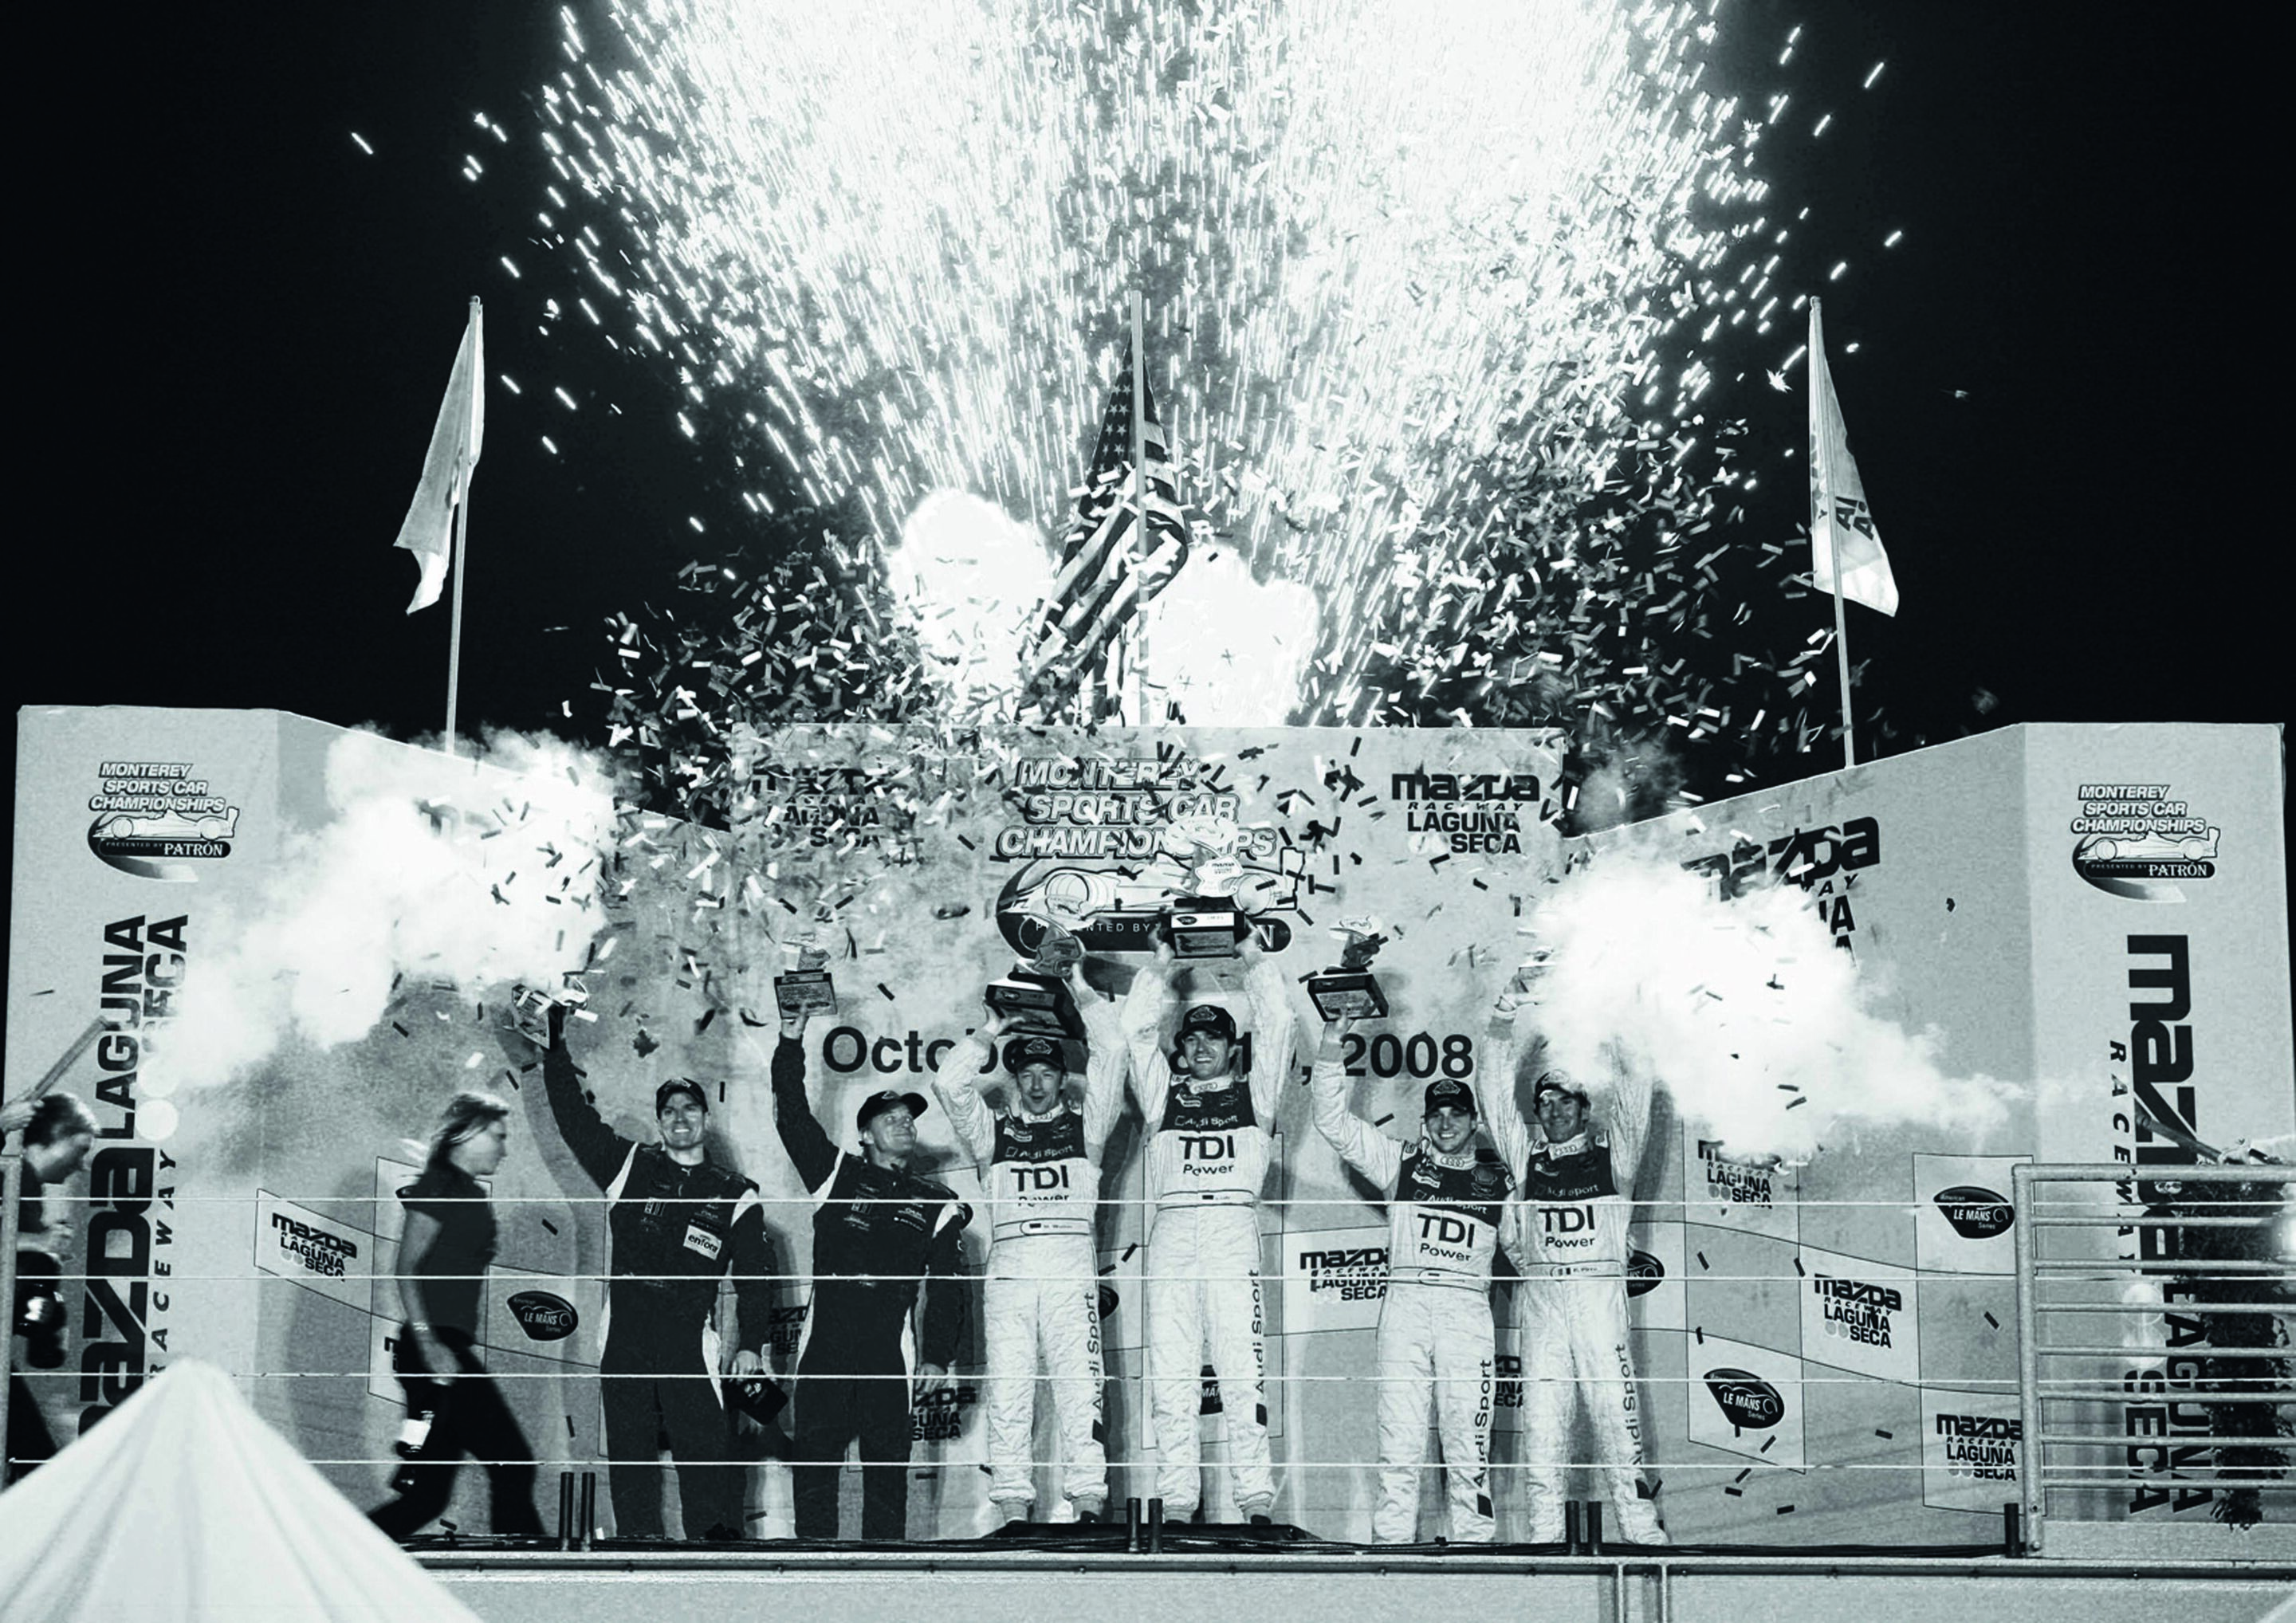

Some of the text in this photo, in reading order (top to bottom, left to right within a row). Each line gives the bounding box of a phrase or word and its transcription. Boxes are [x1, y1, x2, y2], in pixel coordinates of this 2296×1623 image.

[100, 762, 192, 778] MONTEREY
[1016, 759, 1201, 791] MONTEREY
[104, 780, 208, 796] SPORTS CAR
[2079, 785, 2170, 800] MONTEREY
[89, 796, 226, 812] CHAMPIONSHIPS
[1025, 792, 1240, 825] SPORTS CAR
[1408, 802, 1523, 811] RACWAY
[2084, 801, 2187, 817] SPORTS CAR
[1408, 812, 1521, 832] LAGUNA
[2071, 819, 2206, 835] CHAMPIONSHIPS
[1451, 833, 1521, 854] SECA
[1132, 923, 1150, 932] BY
[93, 914, 146, 1140] LAGUNA
[1341, 1031, 1474, 1079] 2008
[1179, 1135, 1235, 1160] TDI
[1010, 1165, 1069, 1192] TDI
[1183, 1164, 1234, 1177] Power
[1708, 1169, 1771, 1195] LAGUNA
[1732, 1188, 1772, 1209] SECA
[1538, 1204, 1595, 1232] TDI
[1953, 1209, 1991, 1222] LE MANS
[1417, 1213, 1475, 1248] TDI
[688, 1234, 718, 1253] enfora
[1420, 1243, 1472, 1261] Power
[1545, 1236, 1595, 1248] Power
[281, 1236, 345, 1271] LAGUNA
[305, 1257, 346, 1282] SECA
[1310, 1271, 1388, 1292] LAGUNA
[1341, 1285, 1388, 1301] SECA
[524, 1312, 558, 1326] LE MANS
[1084, 1292, 1100, 1354] Sport
[1824, 1303, 1891, 1333] LAGUNA
[1248, 1269, 1265, 1394] Audi Sport
[1850, 1325, 1892, 1349] SECA
[1614, 1343, 1637, 1413] Sport
[1724, 1392, 1761, 1411] LE MANS
[1473, 1359, 1492, 1488] Audi Sport
[1947, 1436, 2017, 1448] RACEWAY
[2125, 1370, 2171, 1514] SECA
[1947, 1444, 2015, 1465] LAGUNA
[1973, 1462, 2017, 1481] SECA
